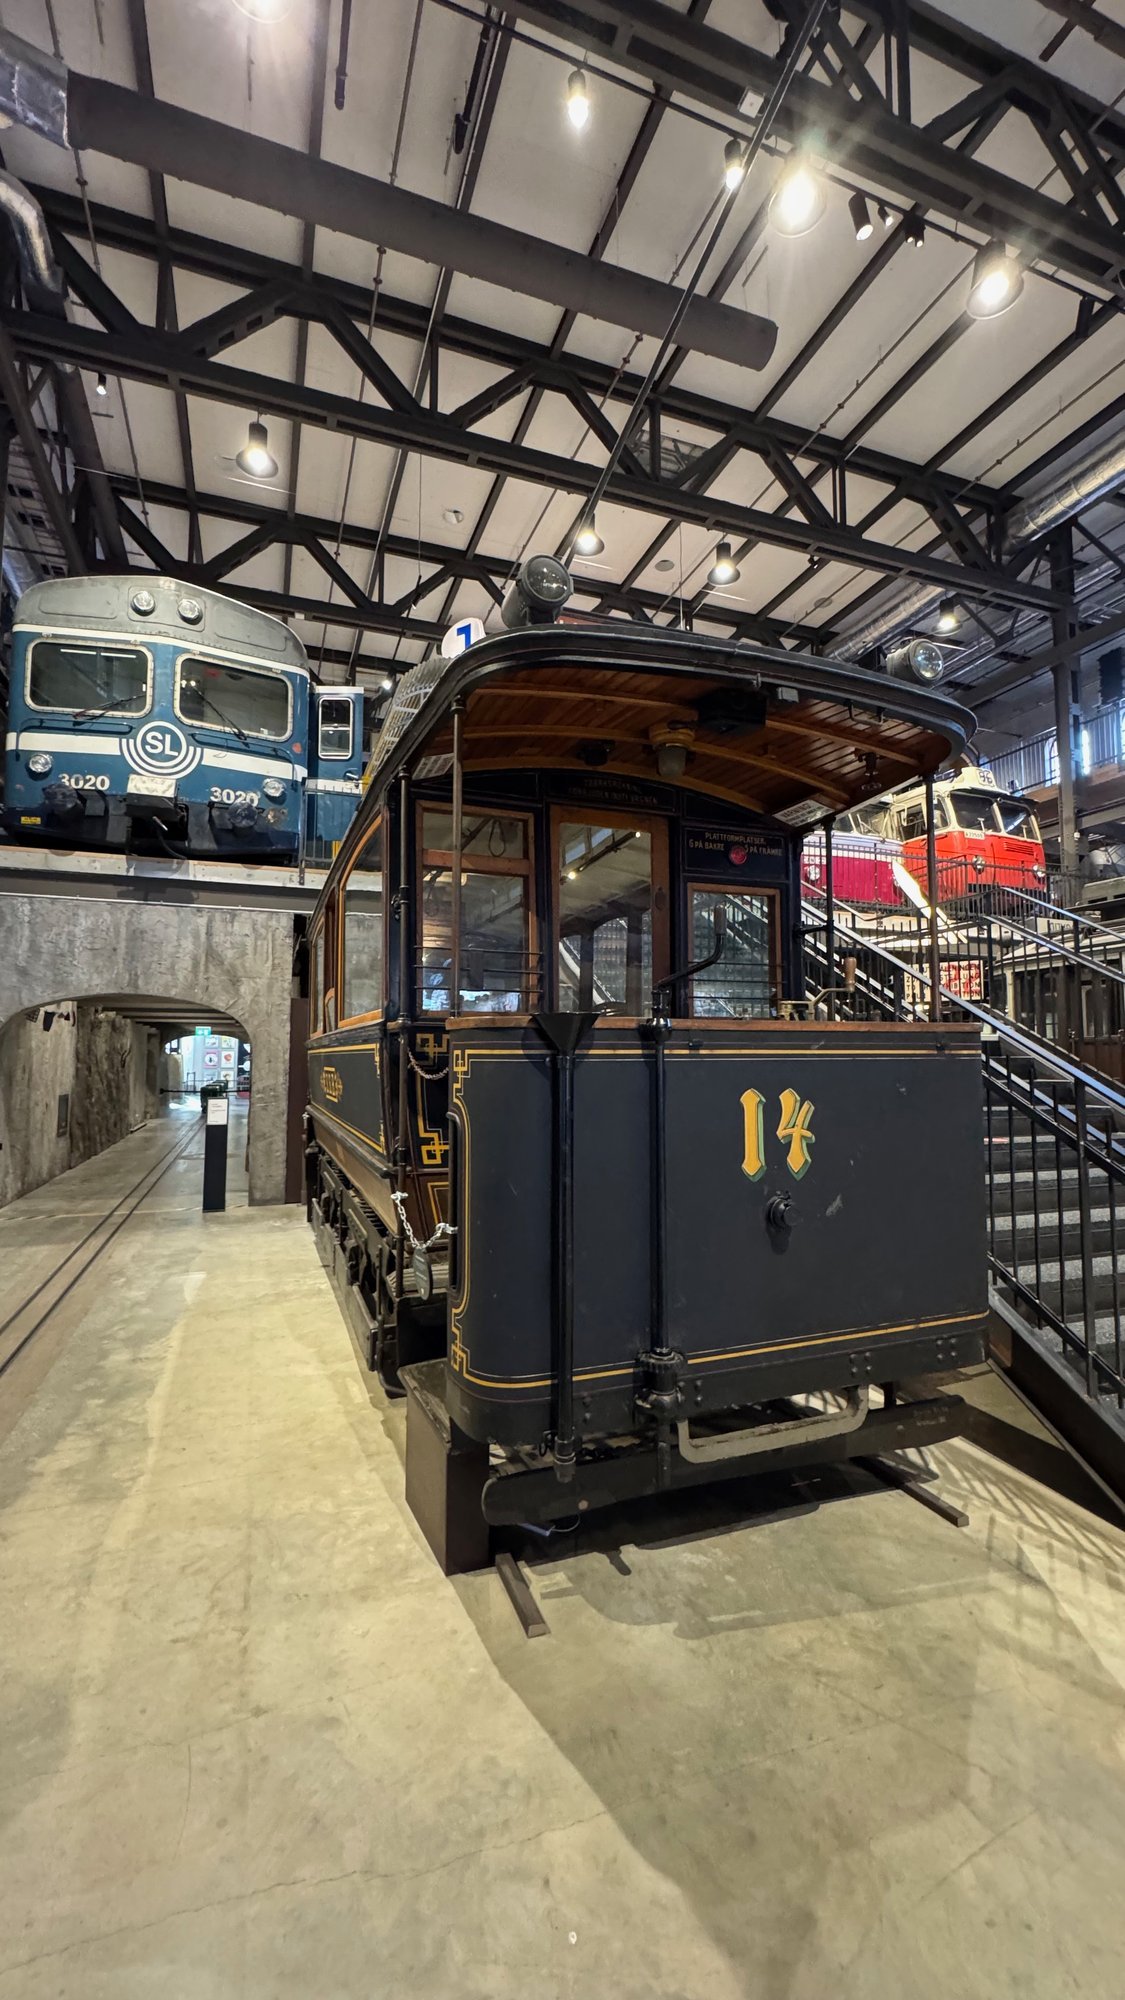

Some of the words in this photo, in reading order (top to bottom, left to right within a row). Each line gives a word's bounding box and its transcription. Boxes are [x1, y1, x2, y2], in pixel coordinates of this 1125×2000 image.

[145, 731, 179, 756] SL
[58, 773, 111, 791] 3020
[209, 787, 261, 807] 3020
[739, 1088, 816, 1182] 14
